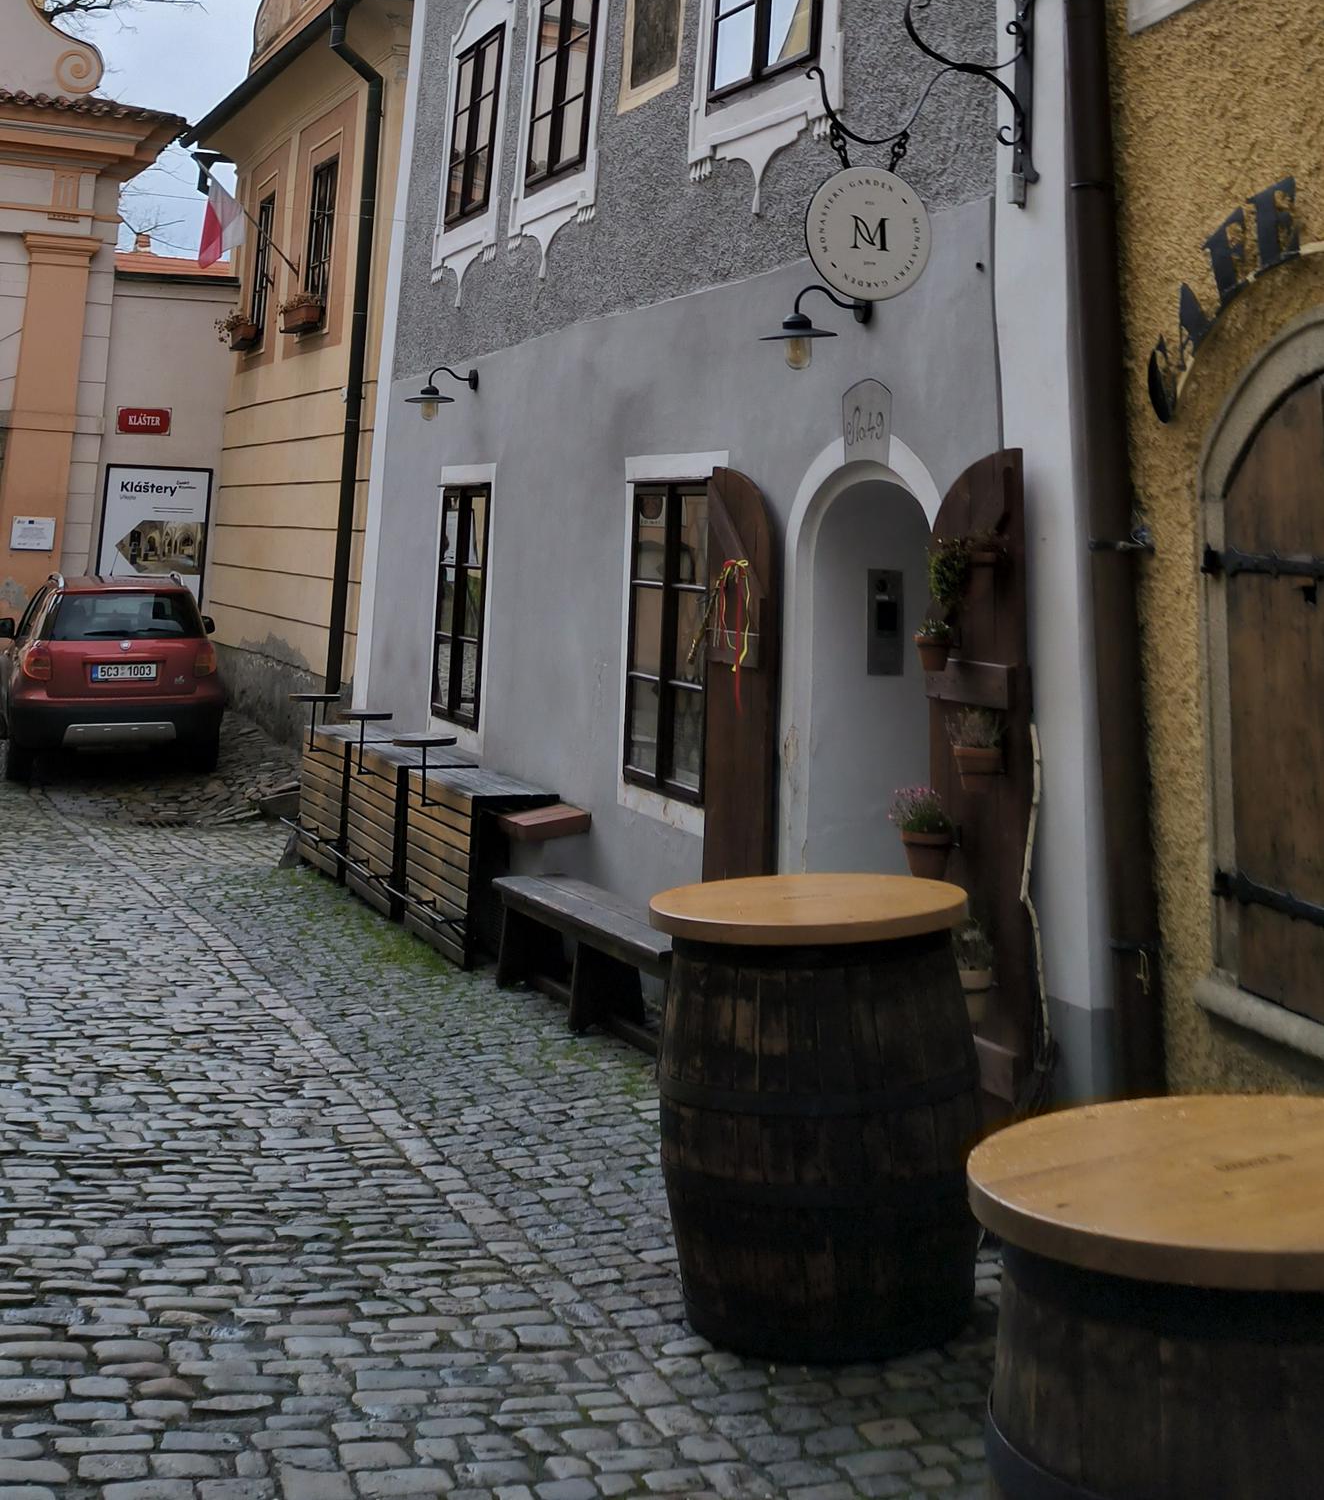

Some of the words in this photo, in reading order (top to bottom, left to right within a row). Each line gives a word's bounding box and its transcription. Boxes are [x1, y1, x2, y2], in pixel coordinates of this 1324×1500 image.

[818, 187, 846, 253] MONASTERY
[848, 178, 894, 193] GARDEN
[849, 214, 890, 252] M
[894, 216, 921, 282] MONASTERY
[843, 273, 889, 288] GARDEN
[1147, 175, 1301, 424] CAFE
[128, 412, 161, 426] KLÁŠTER
[120, 480, 177, 498] Kláštery
[127, 665, 152, 677] 1003
